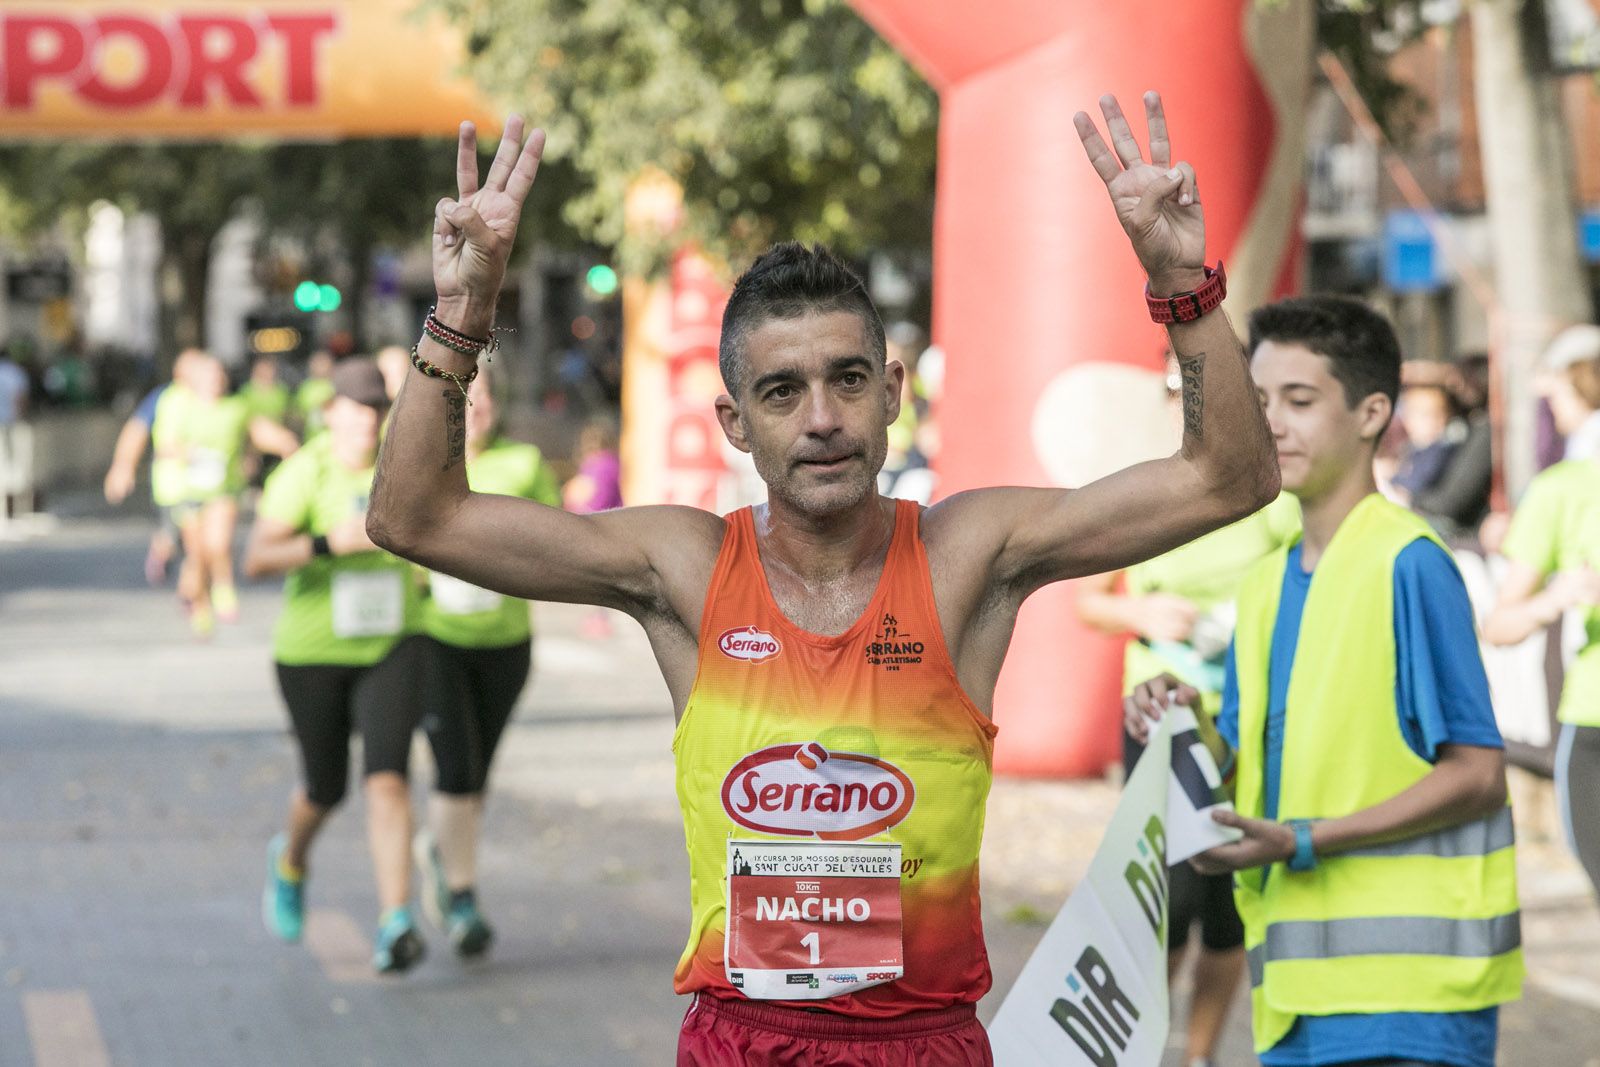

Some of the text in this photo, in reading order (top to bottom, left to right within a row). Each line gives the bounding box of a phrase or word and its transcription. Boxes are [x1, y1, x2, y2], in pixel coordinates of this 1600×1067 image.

[2, 17, 334, 107] PORT
[723, 635, 777, 653] Serrano
[865, 641, 925, 657] SERRANO
[736, 770, 898, 813] Serrano
[763, 855, 788, 863] CURSA
[754, 863, 779, 872] SANT
[784, 863, 819, 873] CUGAT
[825, 864, 846, 873] DEL
[796, 883, 820, 891] 10Km
[755, 896, 871, 922] NACHO
[800, 931, 820, 965] 1
[866, 972, 897, 981] SPORT
